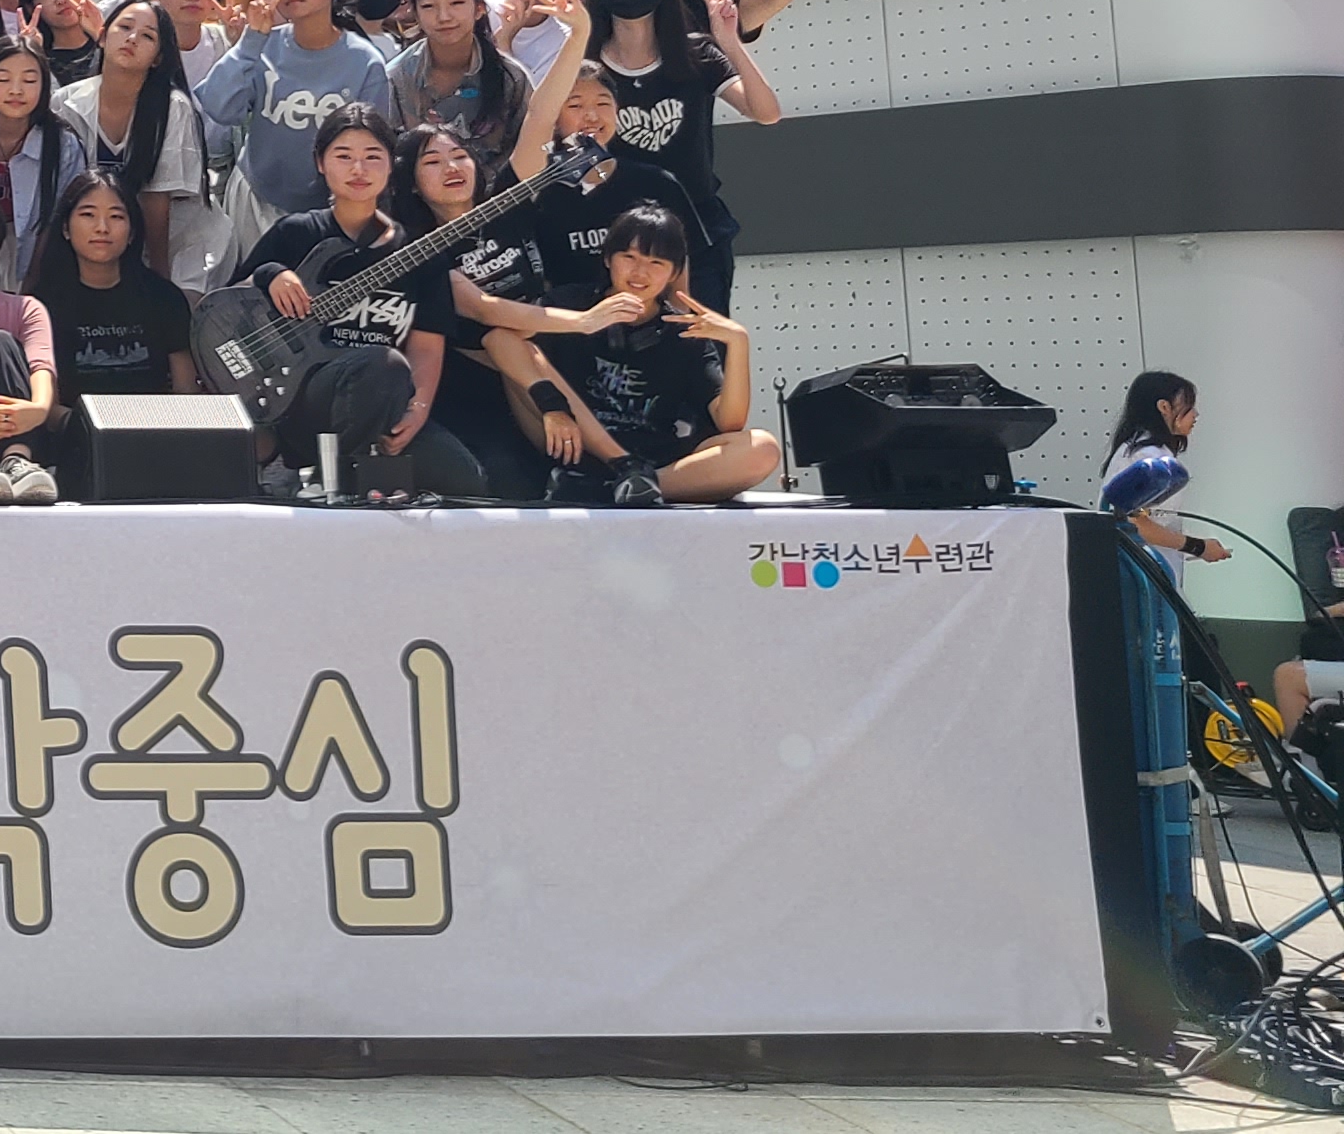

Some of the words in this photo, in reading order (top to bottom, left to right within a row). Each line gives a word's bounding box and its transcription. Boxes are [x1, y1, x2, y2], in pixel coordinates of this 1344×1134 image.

[260, 70, 346, 131] Lee
[620, 118, 683, 153] LEGACY
[568, 228, 609, 251] FLOR
[333, 328, 360, 341] NEW
[361, 332, 393, 345] YORK
[748, 533, 995, 588] 강남청소년수련관
